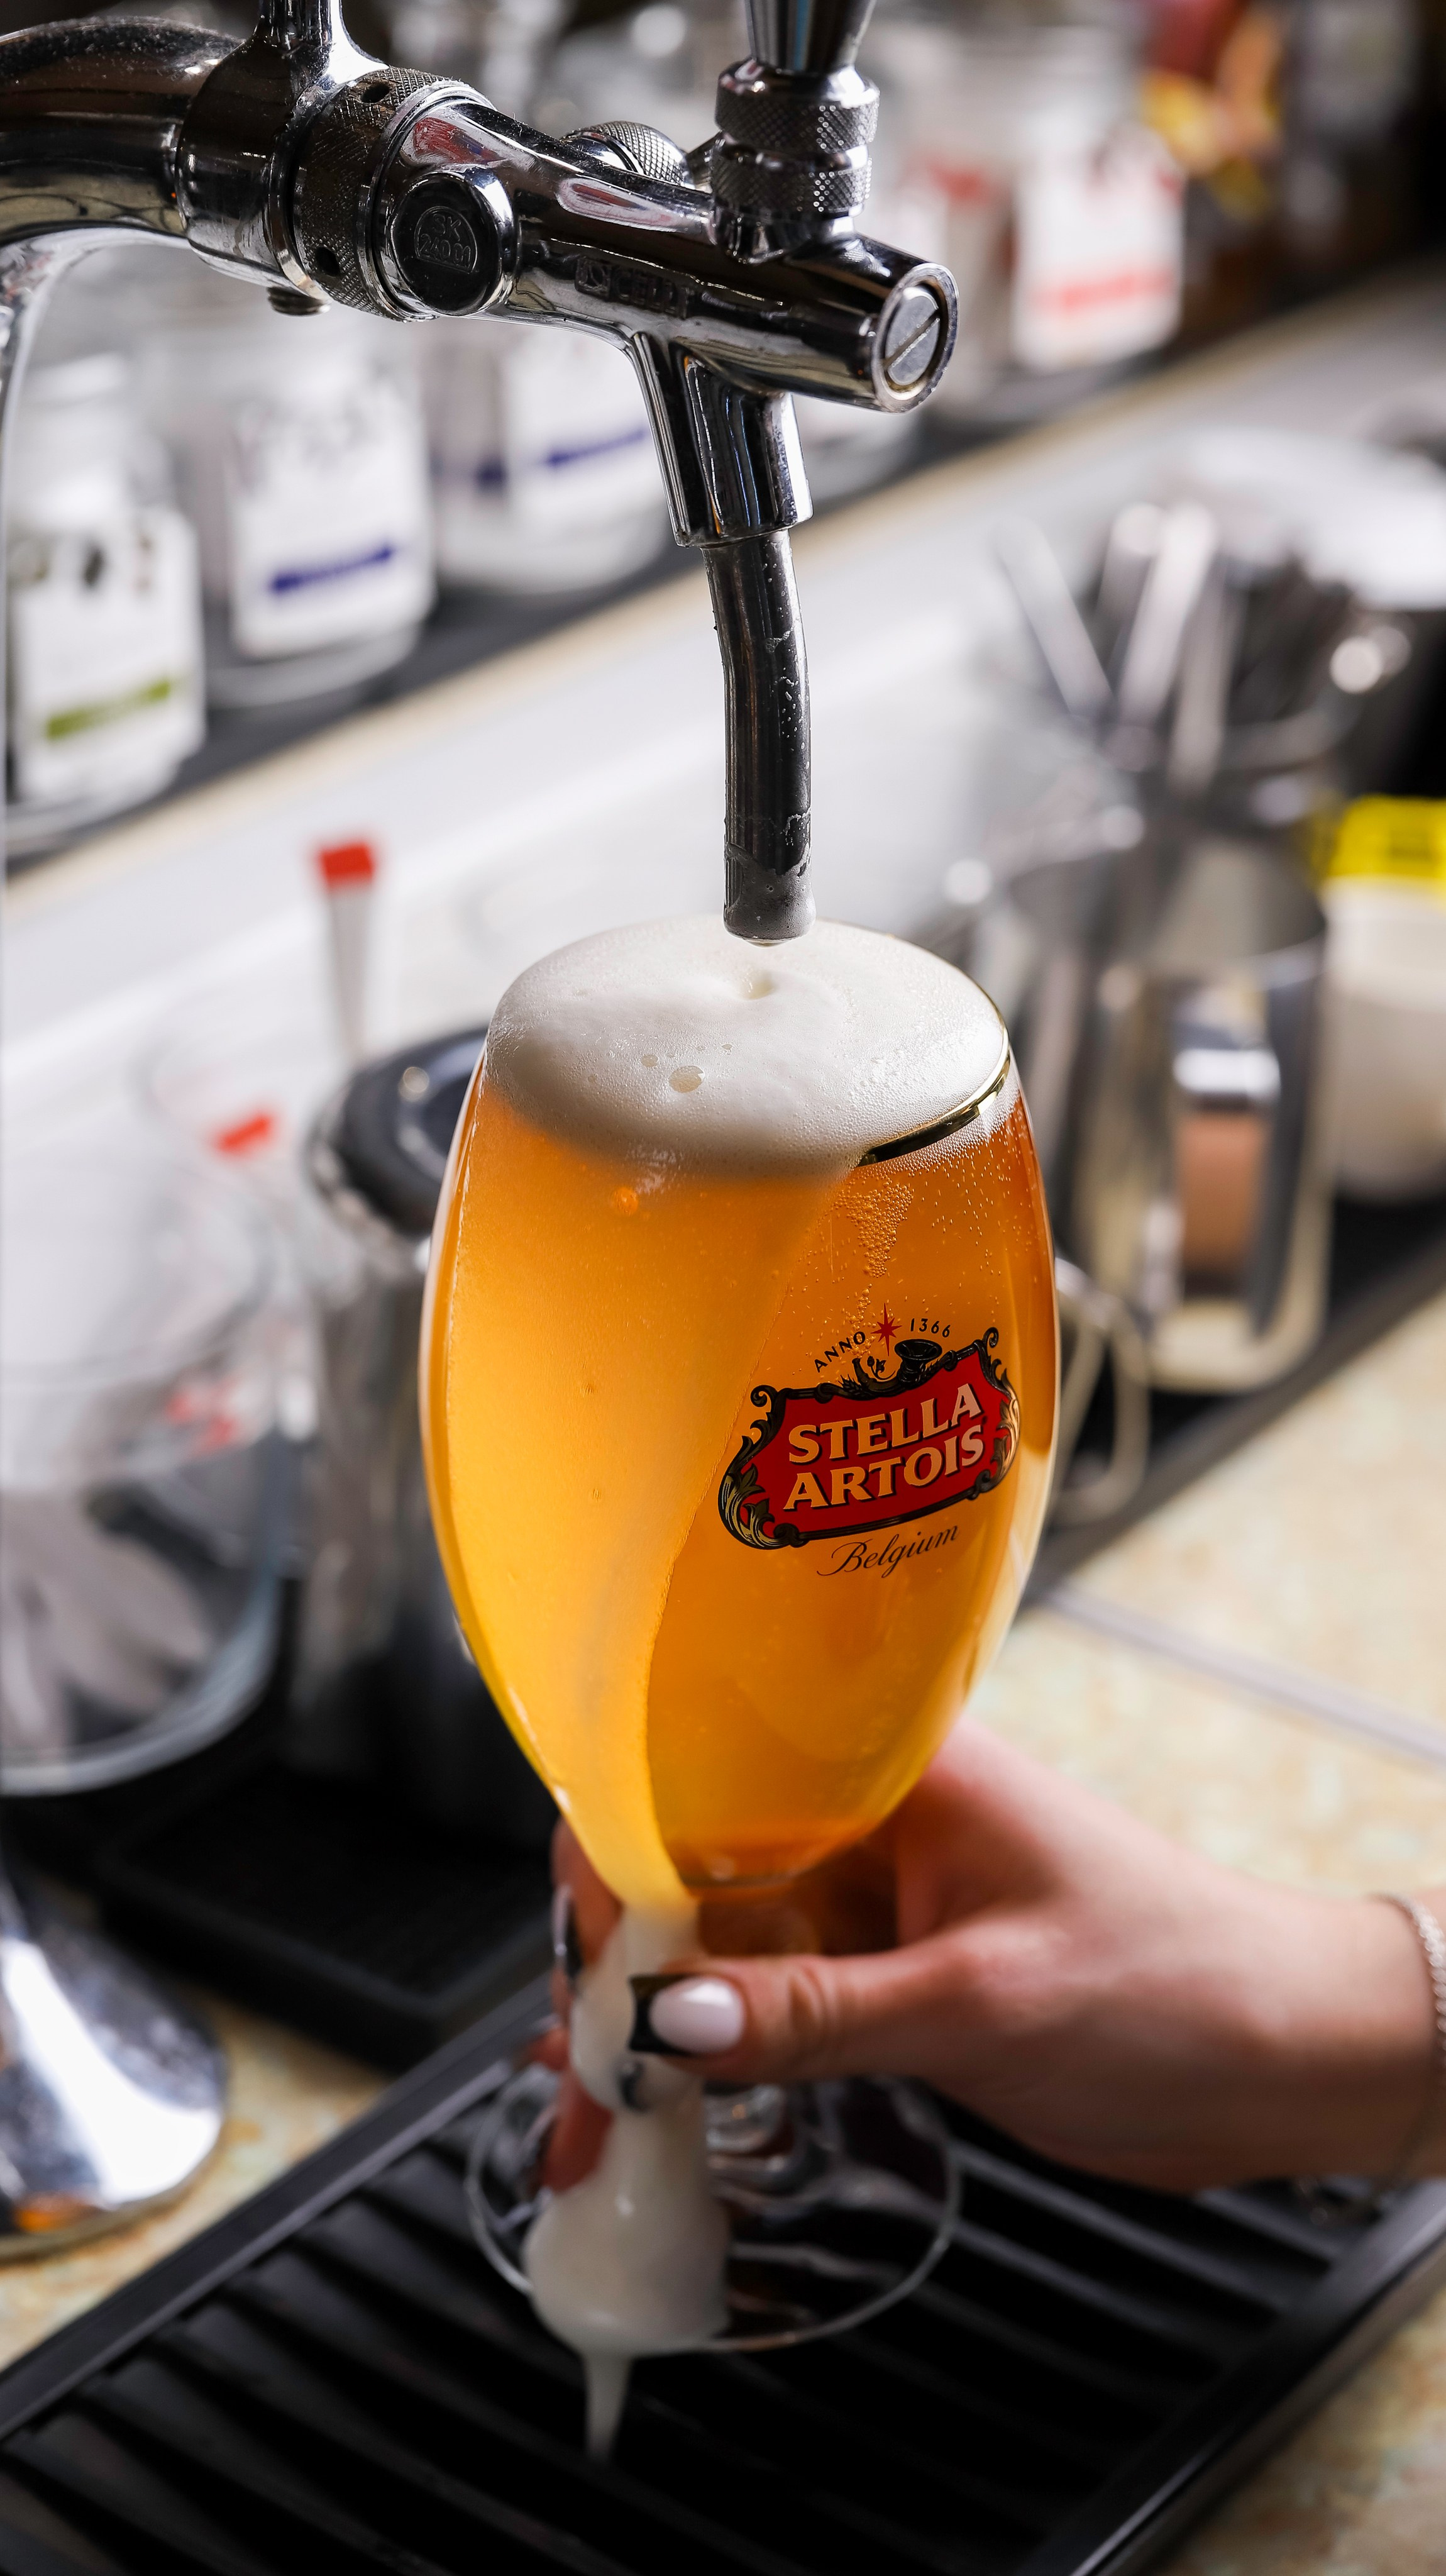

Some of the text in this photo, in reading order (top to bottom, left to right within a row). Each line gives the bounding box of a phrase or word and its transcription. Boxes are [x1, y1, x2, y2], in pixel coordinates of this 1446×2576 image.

[433, 213, 461, 242] SK
[814, 1318, 951, 1373] ANNO 1366
[788, 1383, 983, 1465] STELLA
[783, 1424, 984, 1511] ARTOIS
[816, 1525, 958, 1579] Belgium
